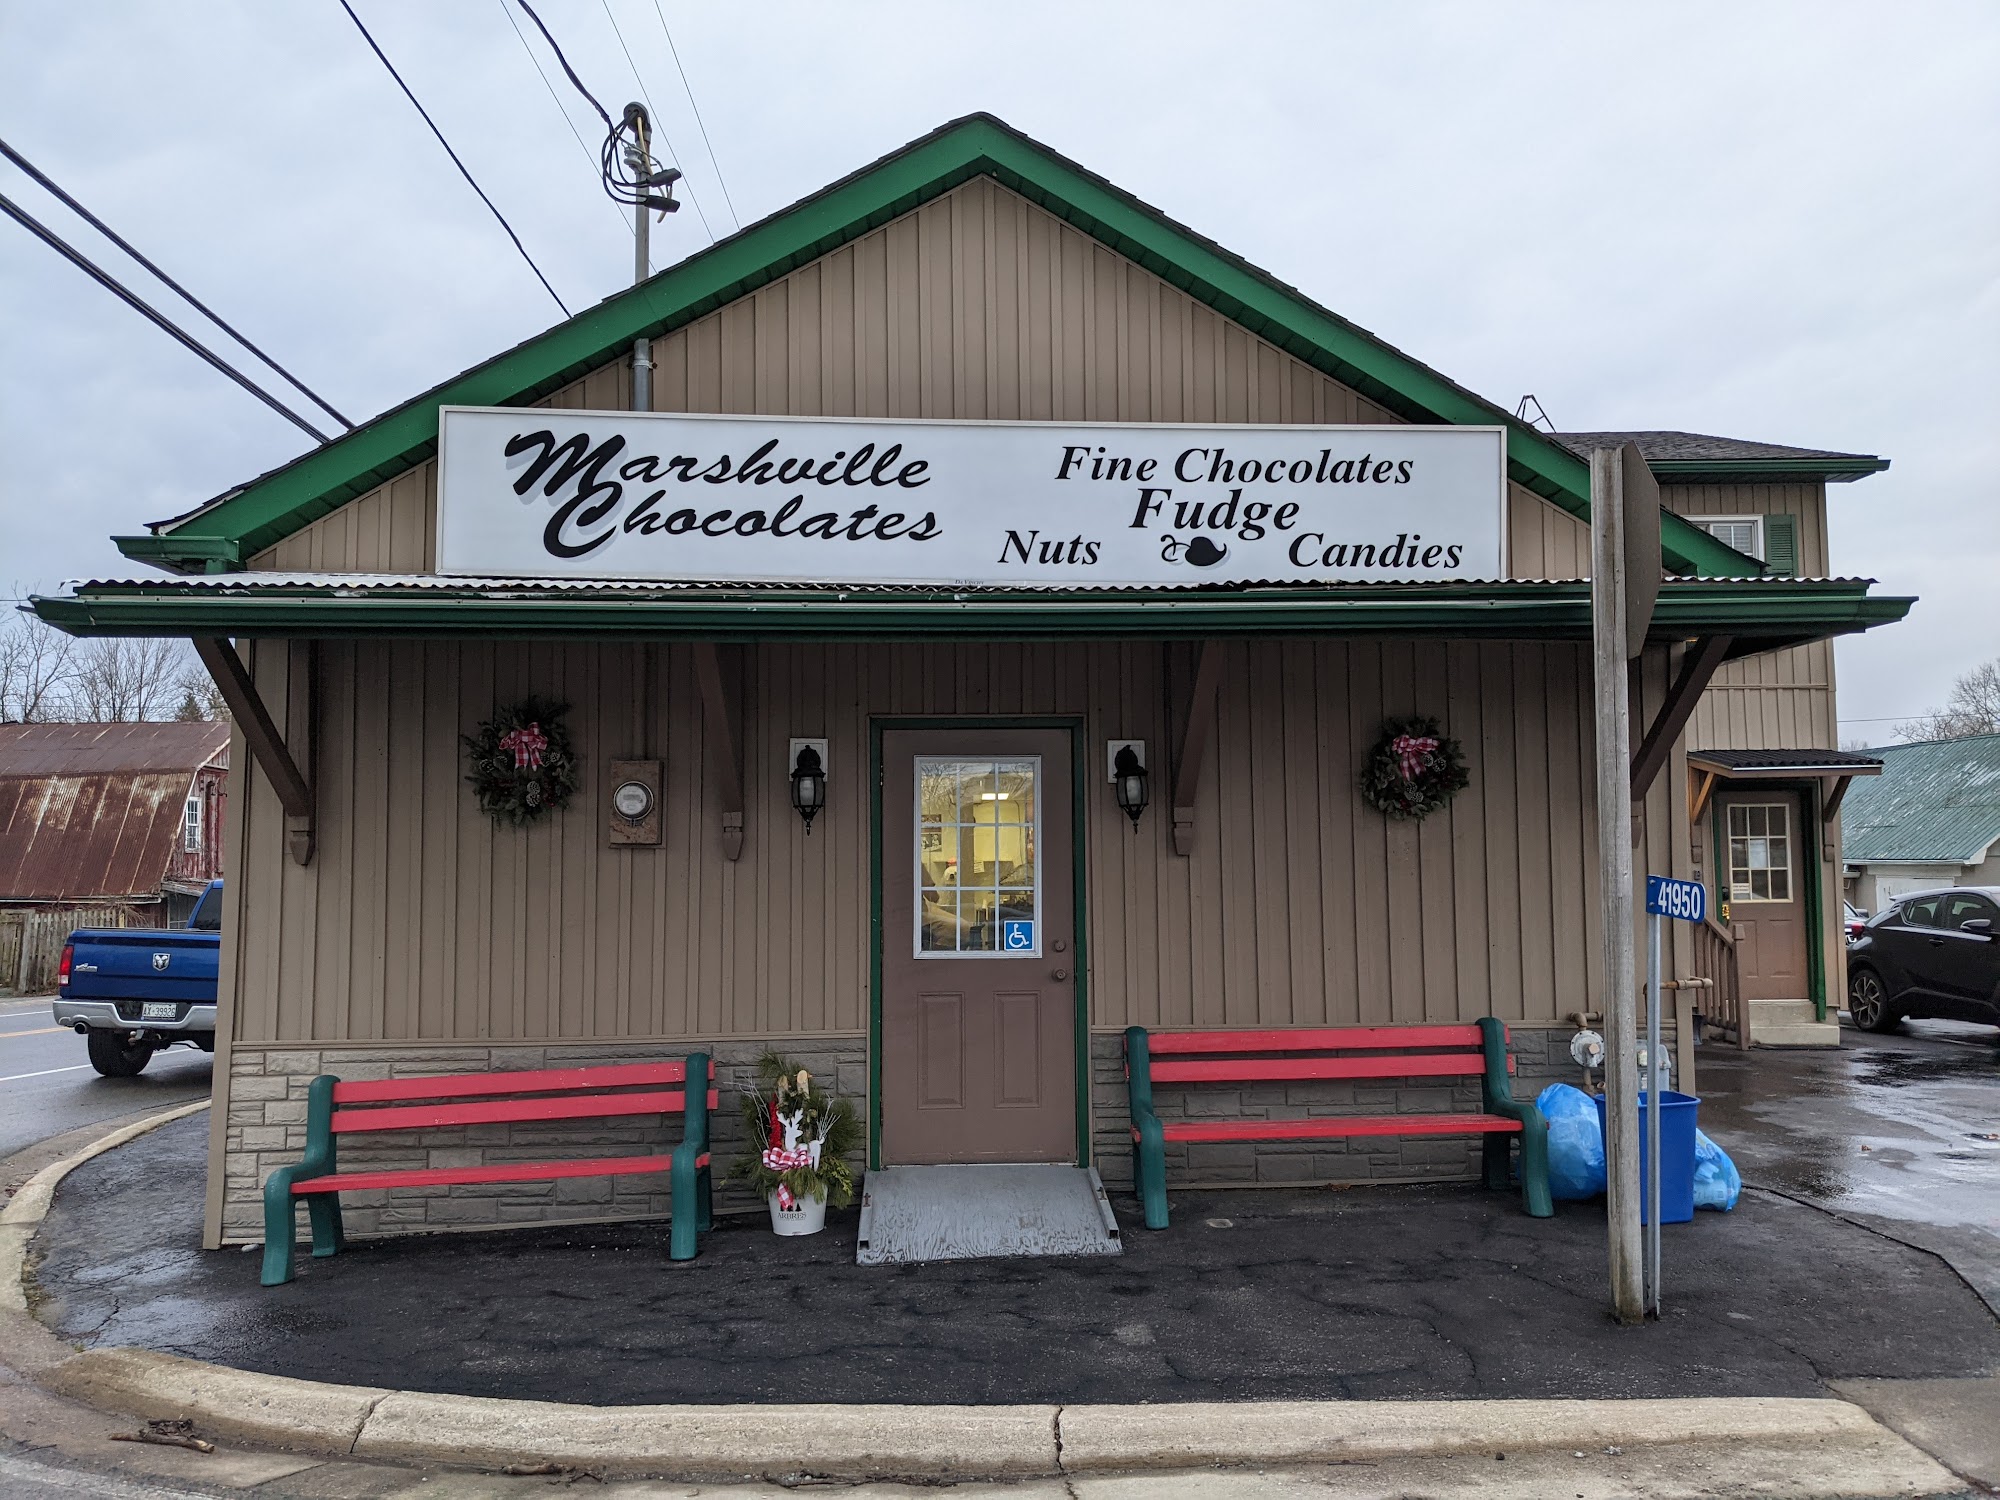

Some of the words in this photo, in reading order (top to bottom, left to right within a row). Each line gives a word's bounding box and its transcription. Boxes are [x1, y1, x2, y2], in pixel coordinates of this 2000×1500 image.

[504, 430, 931, 497] Marshville
[1055, 447, 1158, 482] Fine
[1174, 448, 1414, 484] Chocolates
[543, 484, 942, 558] Chocolates
[1129, 488, 1300, 541] Fudge
[998, 530, 1101, 565] Nuts
[1288, 532, 1463, 568] Candies
[1658, 882, 1700, 919] 41950
